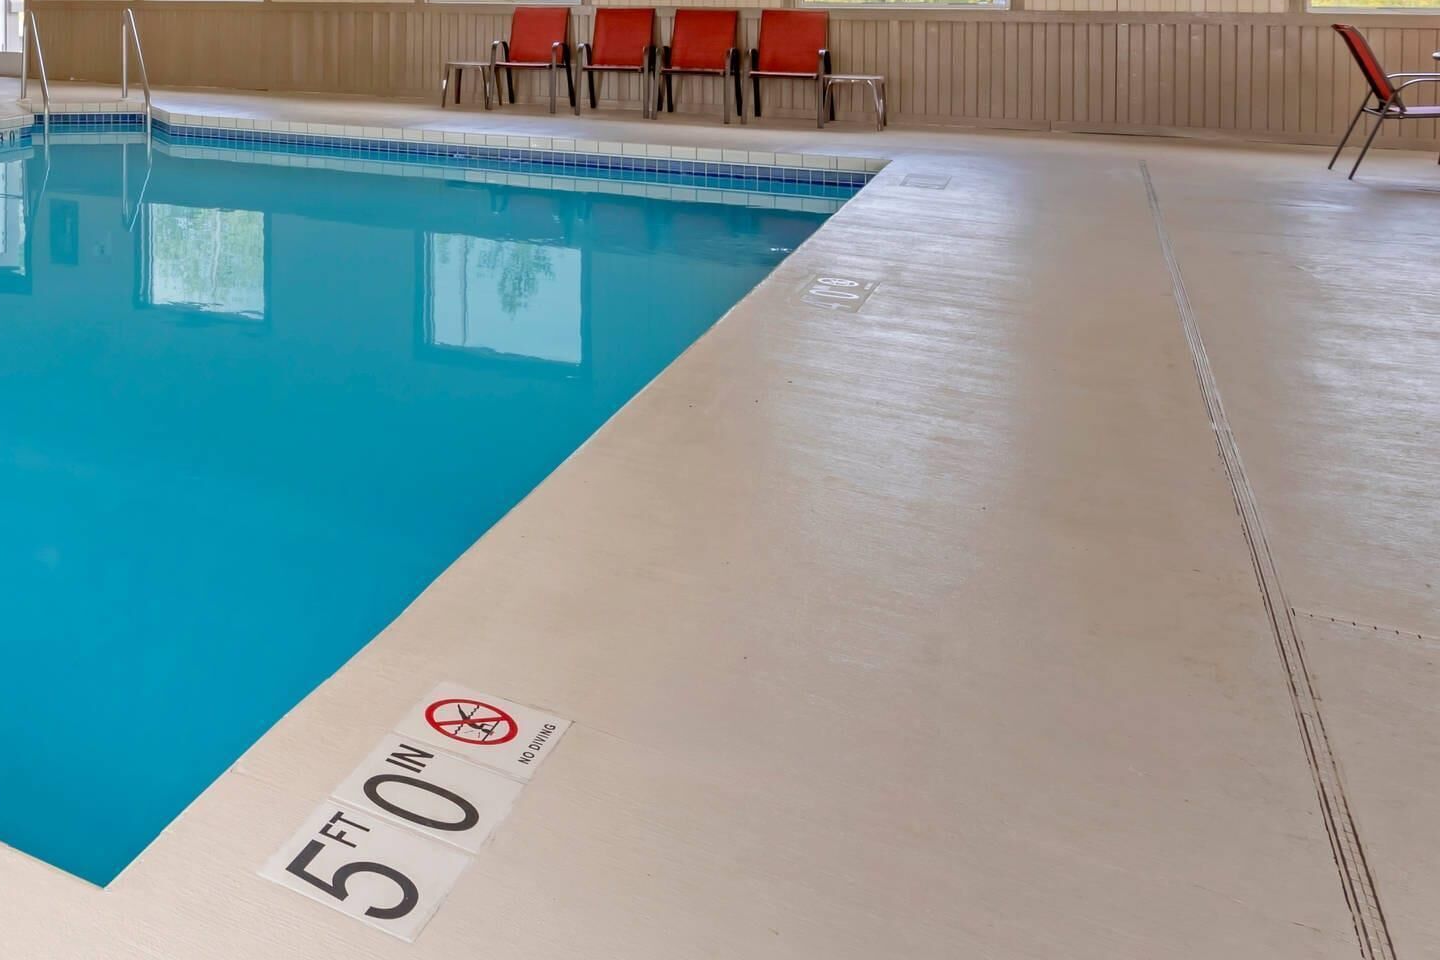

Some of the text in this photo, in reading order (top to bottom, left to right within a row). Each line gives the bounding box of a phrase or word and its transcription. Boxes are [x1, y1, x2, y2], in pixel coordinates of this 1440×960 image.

[517, 722, 557, 766] NO DIVING
[285, 743, 480, 920] 5 FT 0 IN
